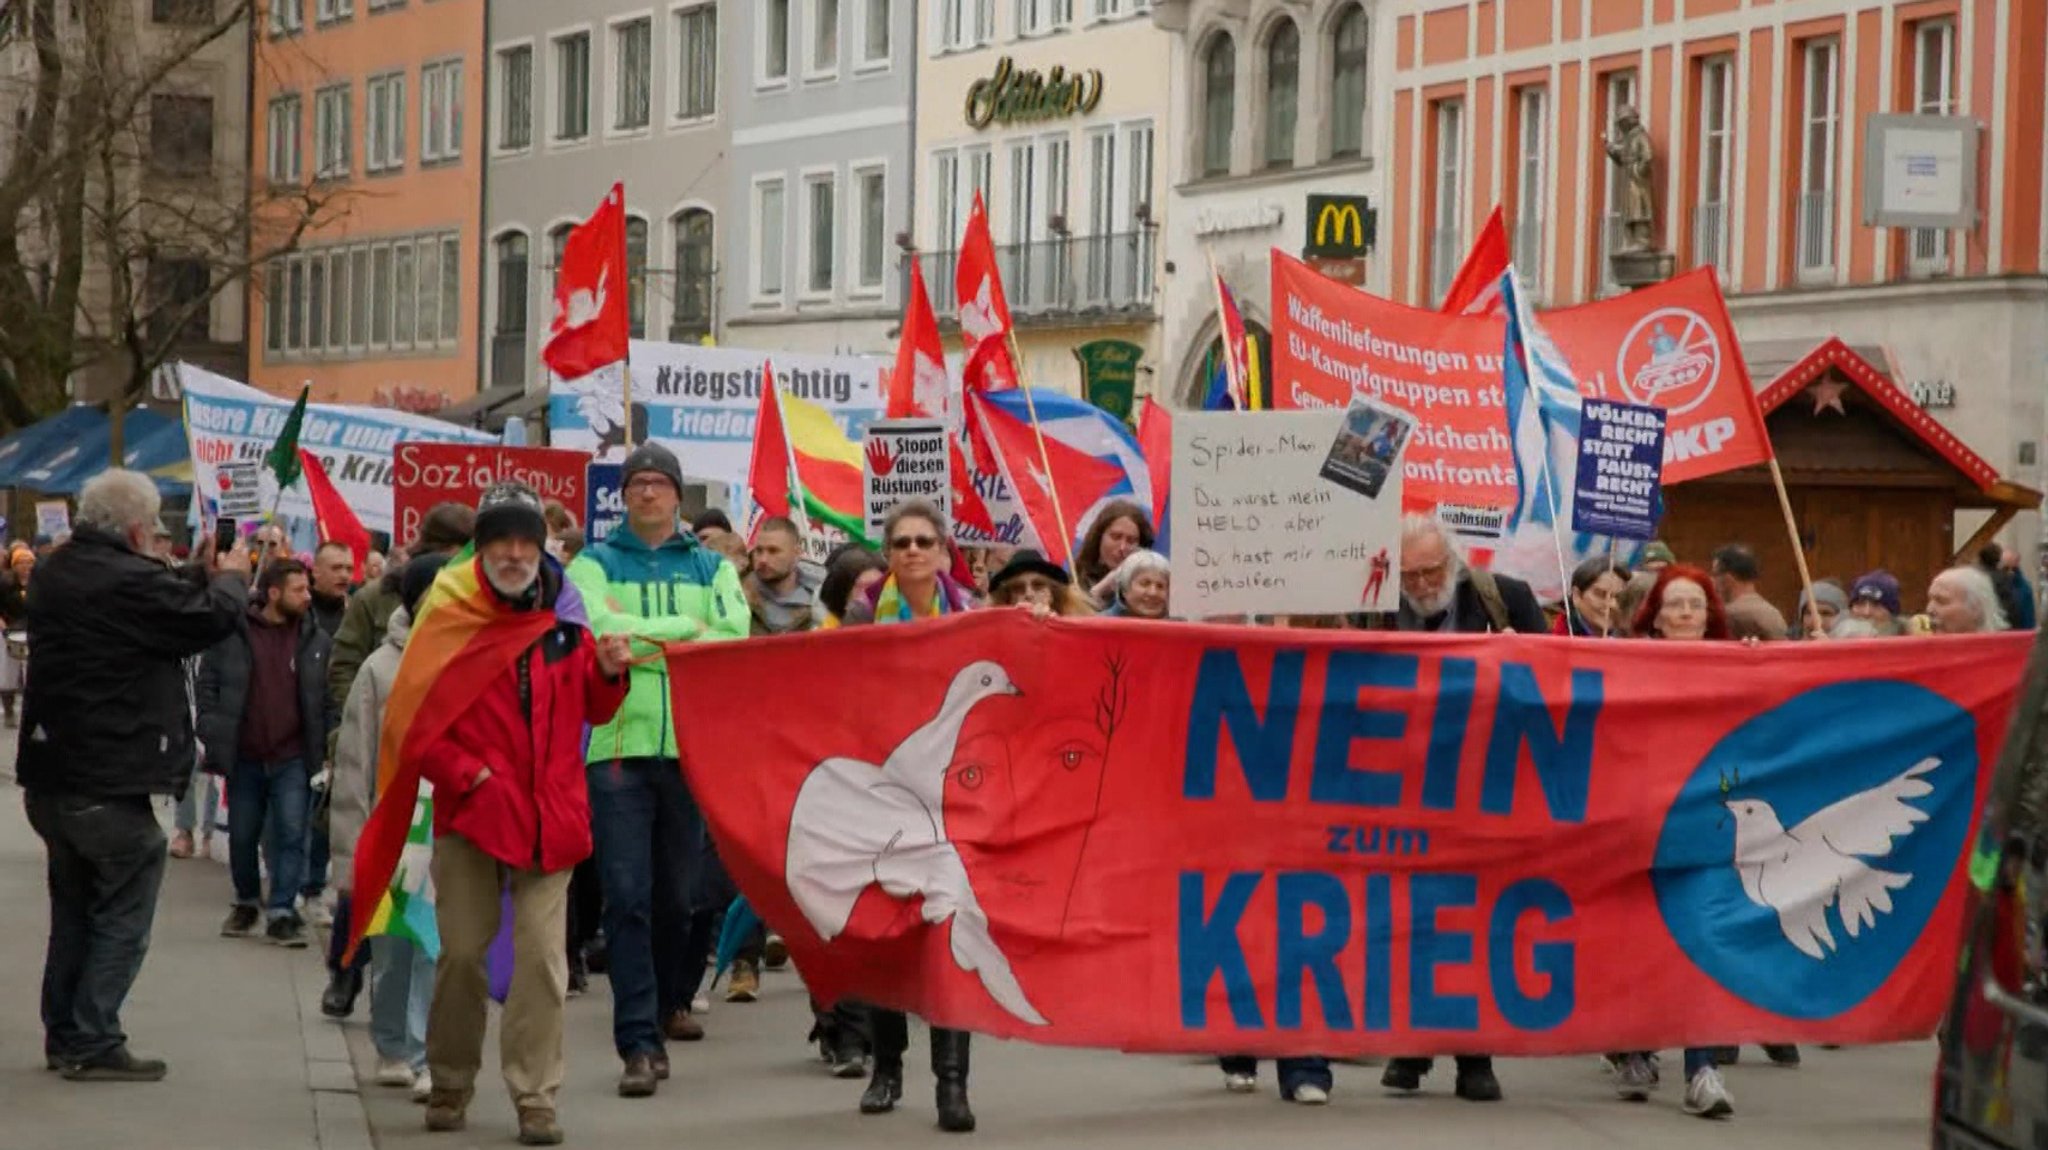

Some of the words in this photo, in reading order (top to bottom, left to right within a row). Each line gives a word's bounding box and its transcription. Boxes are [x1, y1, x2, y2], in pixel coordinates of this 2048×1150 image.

[1287, 293, 1468, 374] Waffenlieferungen
[1288, 333, 1470, 407] EU-Kampfgruppen
[1586, 403, 1665, 429] VÖLKER-
[896, 436, 943, 454] Stoppt
[1601, 424, 1658, 446] RECHT
[1582, 439, 1634, 459] STATT
[398, 446, 577, 498] Sozialismus
[896, 457, 944, 473] diesen
[1597, 458, 1659, 478] FAUST-
[871, 477, 944, 495] Rüstungs-
[1596, 475, 1653, 496] RECHT
[1194, 487, 1221, 507] Du
[1288, 488, 1332, 504] mein
[1197, 514, 1261, 532] HELD
[1284, 511, 1325, 532] aber
[1231, 550, 1273, 564] hast
[1284, 549, 1313, 564] mir
[1325, 543, 1367, 560] nicht
[1196, 572, 1287, 598] geholfen
[1182, 647, 1606, 823] NEIN
[1326, 824, 1431, 854] zum
[1177, 869, 1577, 1031] KRIEG
